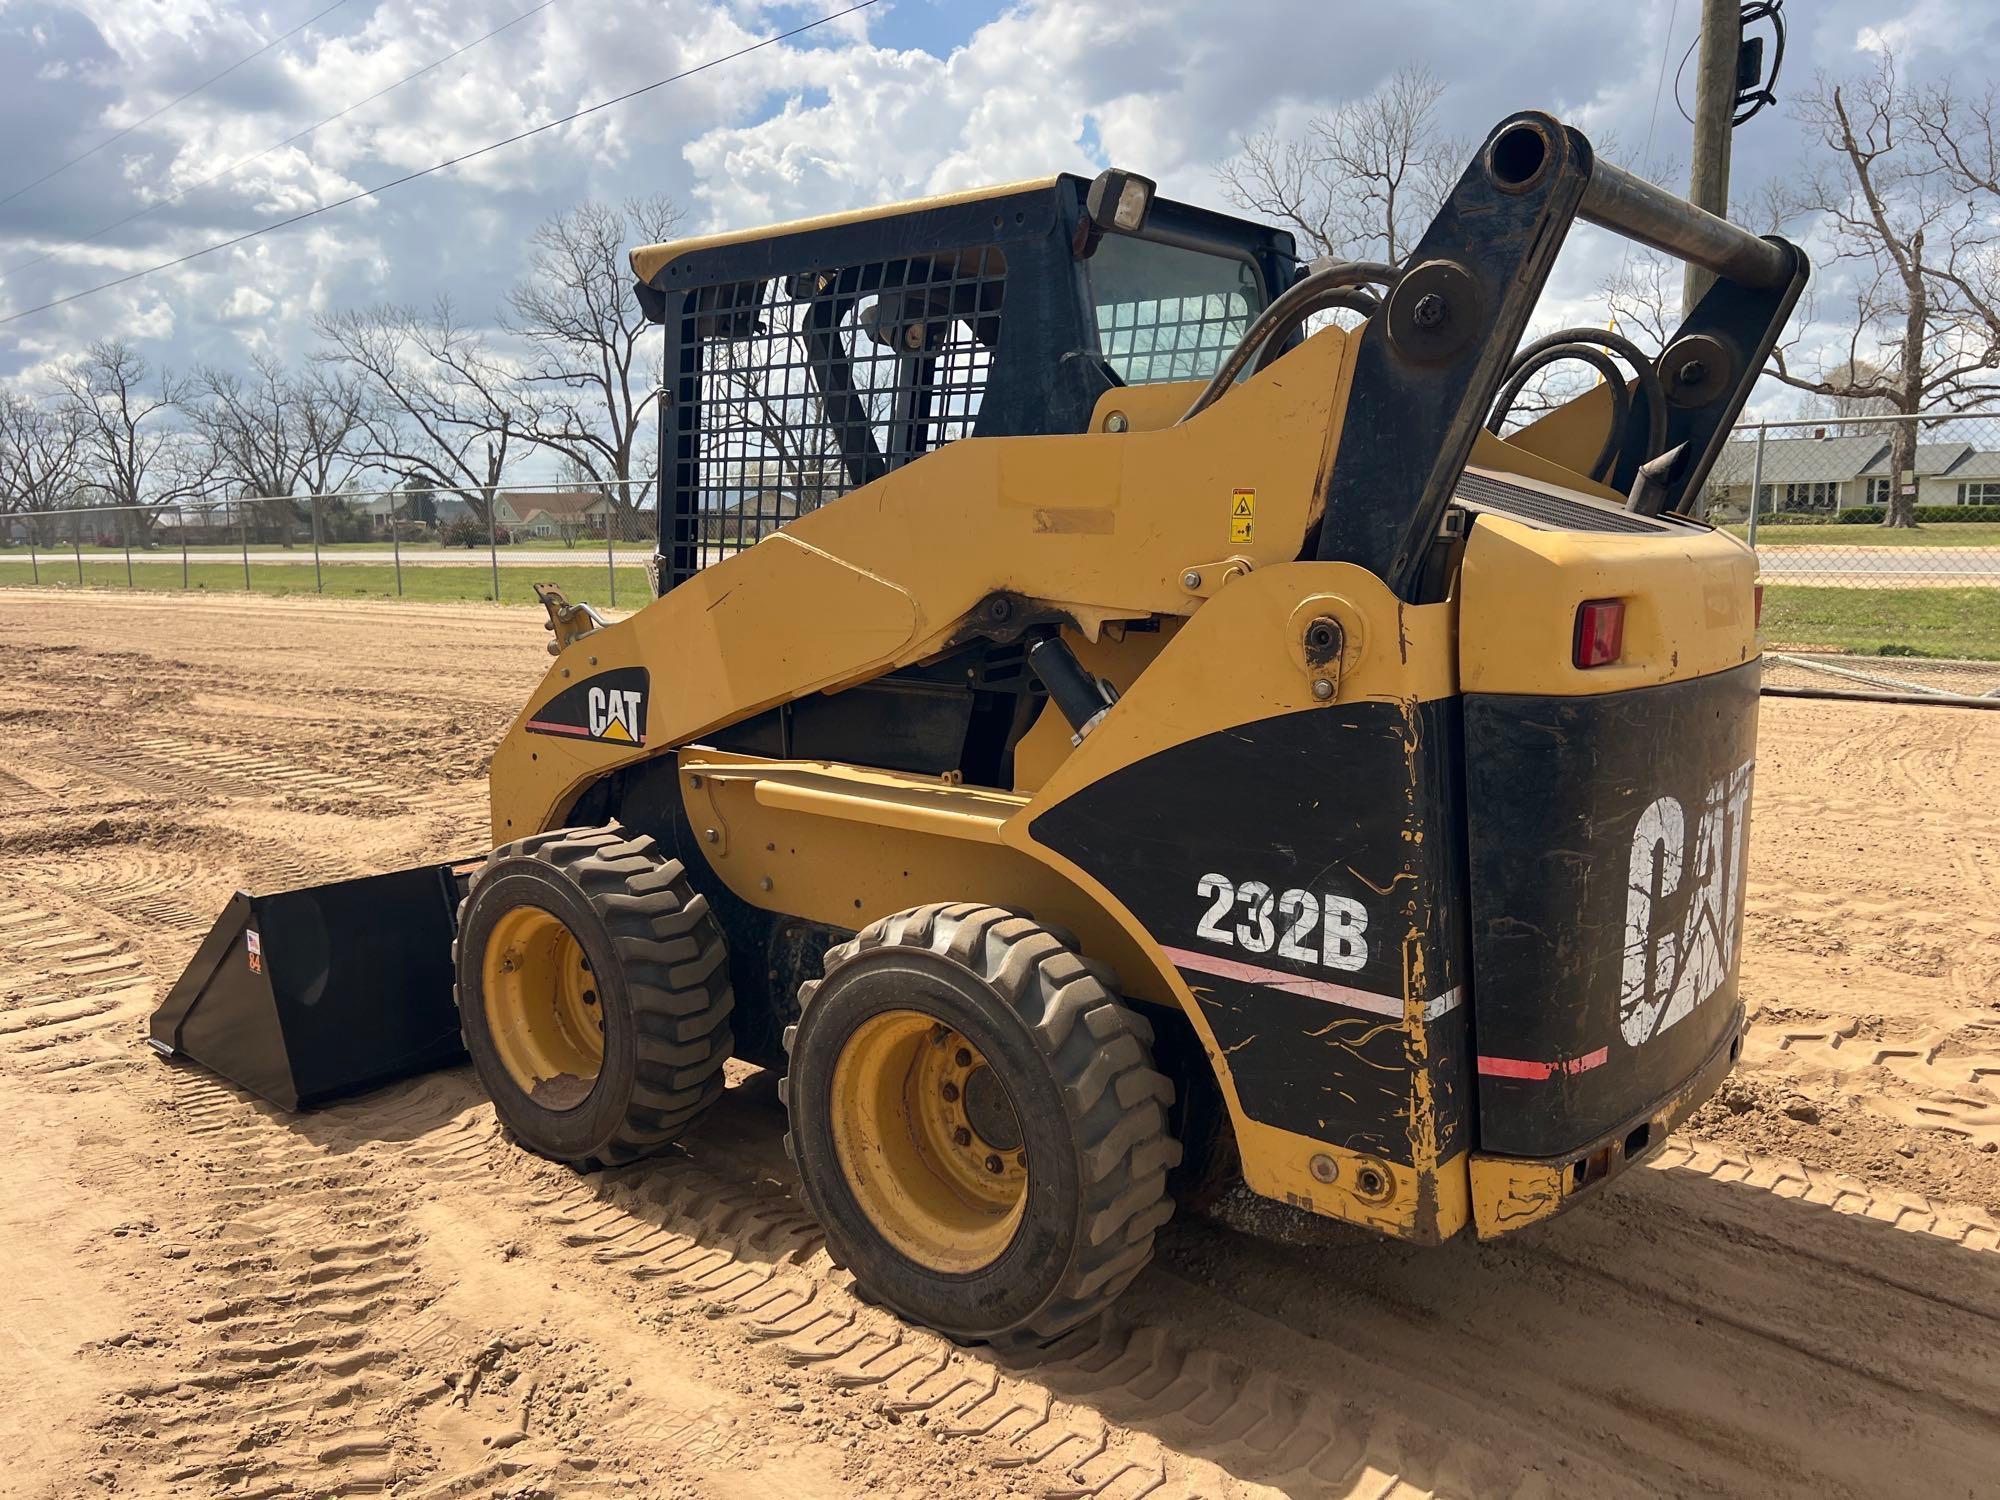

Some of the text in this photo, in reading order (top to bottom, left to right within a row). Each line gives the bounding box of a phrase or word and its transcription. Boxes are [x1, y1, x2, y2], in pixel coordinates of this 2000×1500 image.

[588, 686, 641, 742] CAT
[1197, 873, 1368, 972] 232B
[1620, 759, 1754, 1047] CAT
